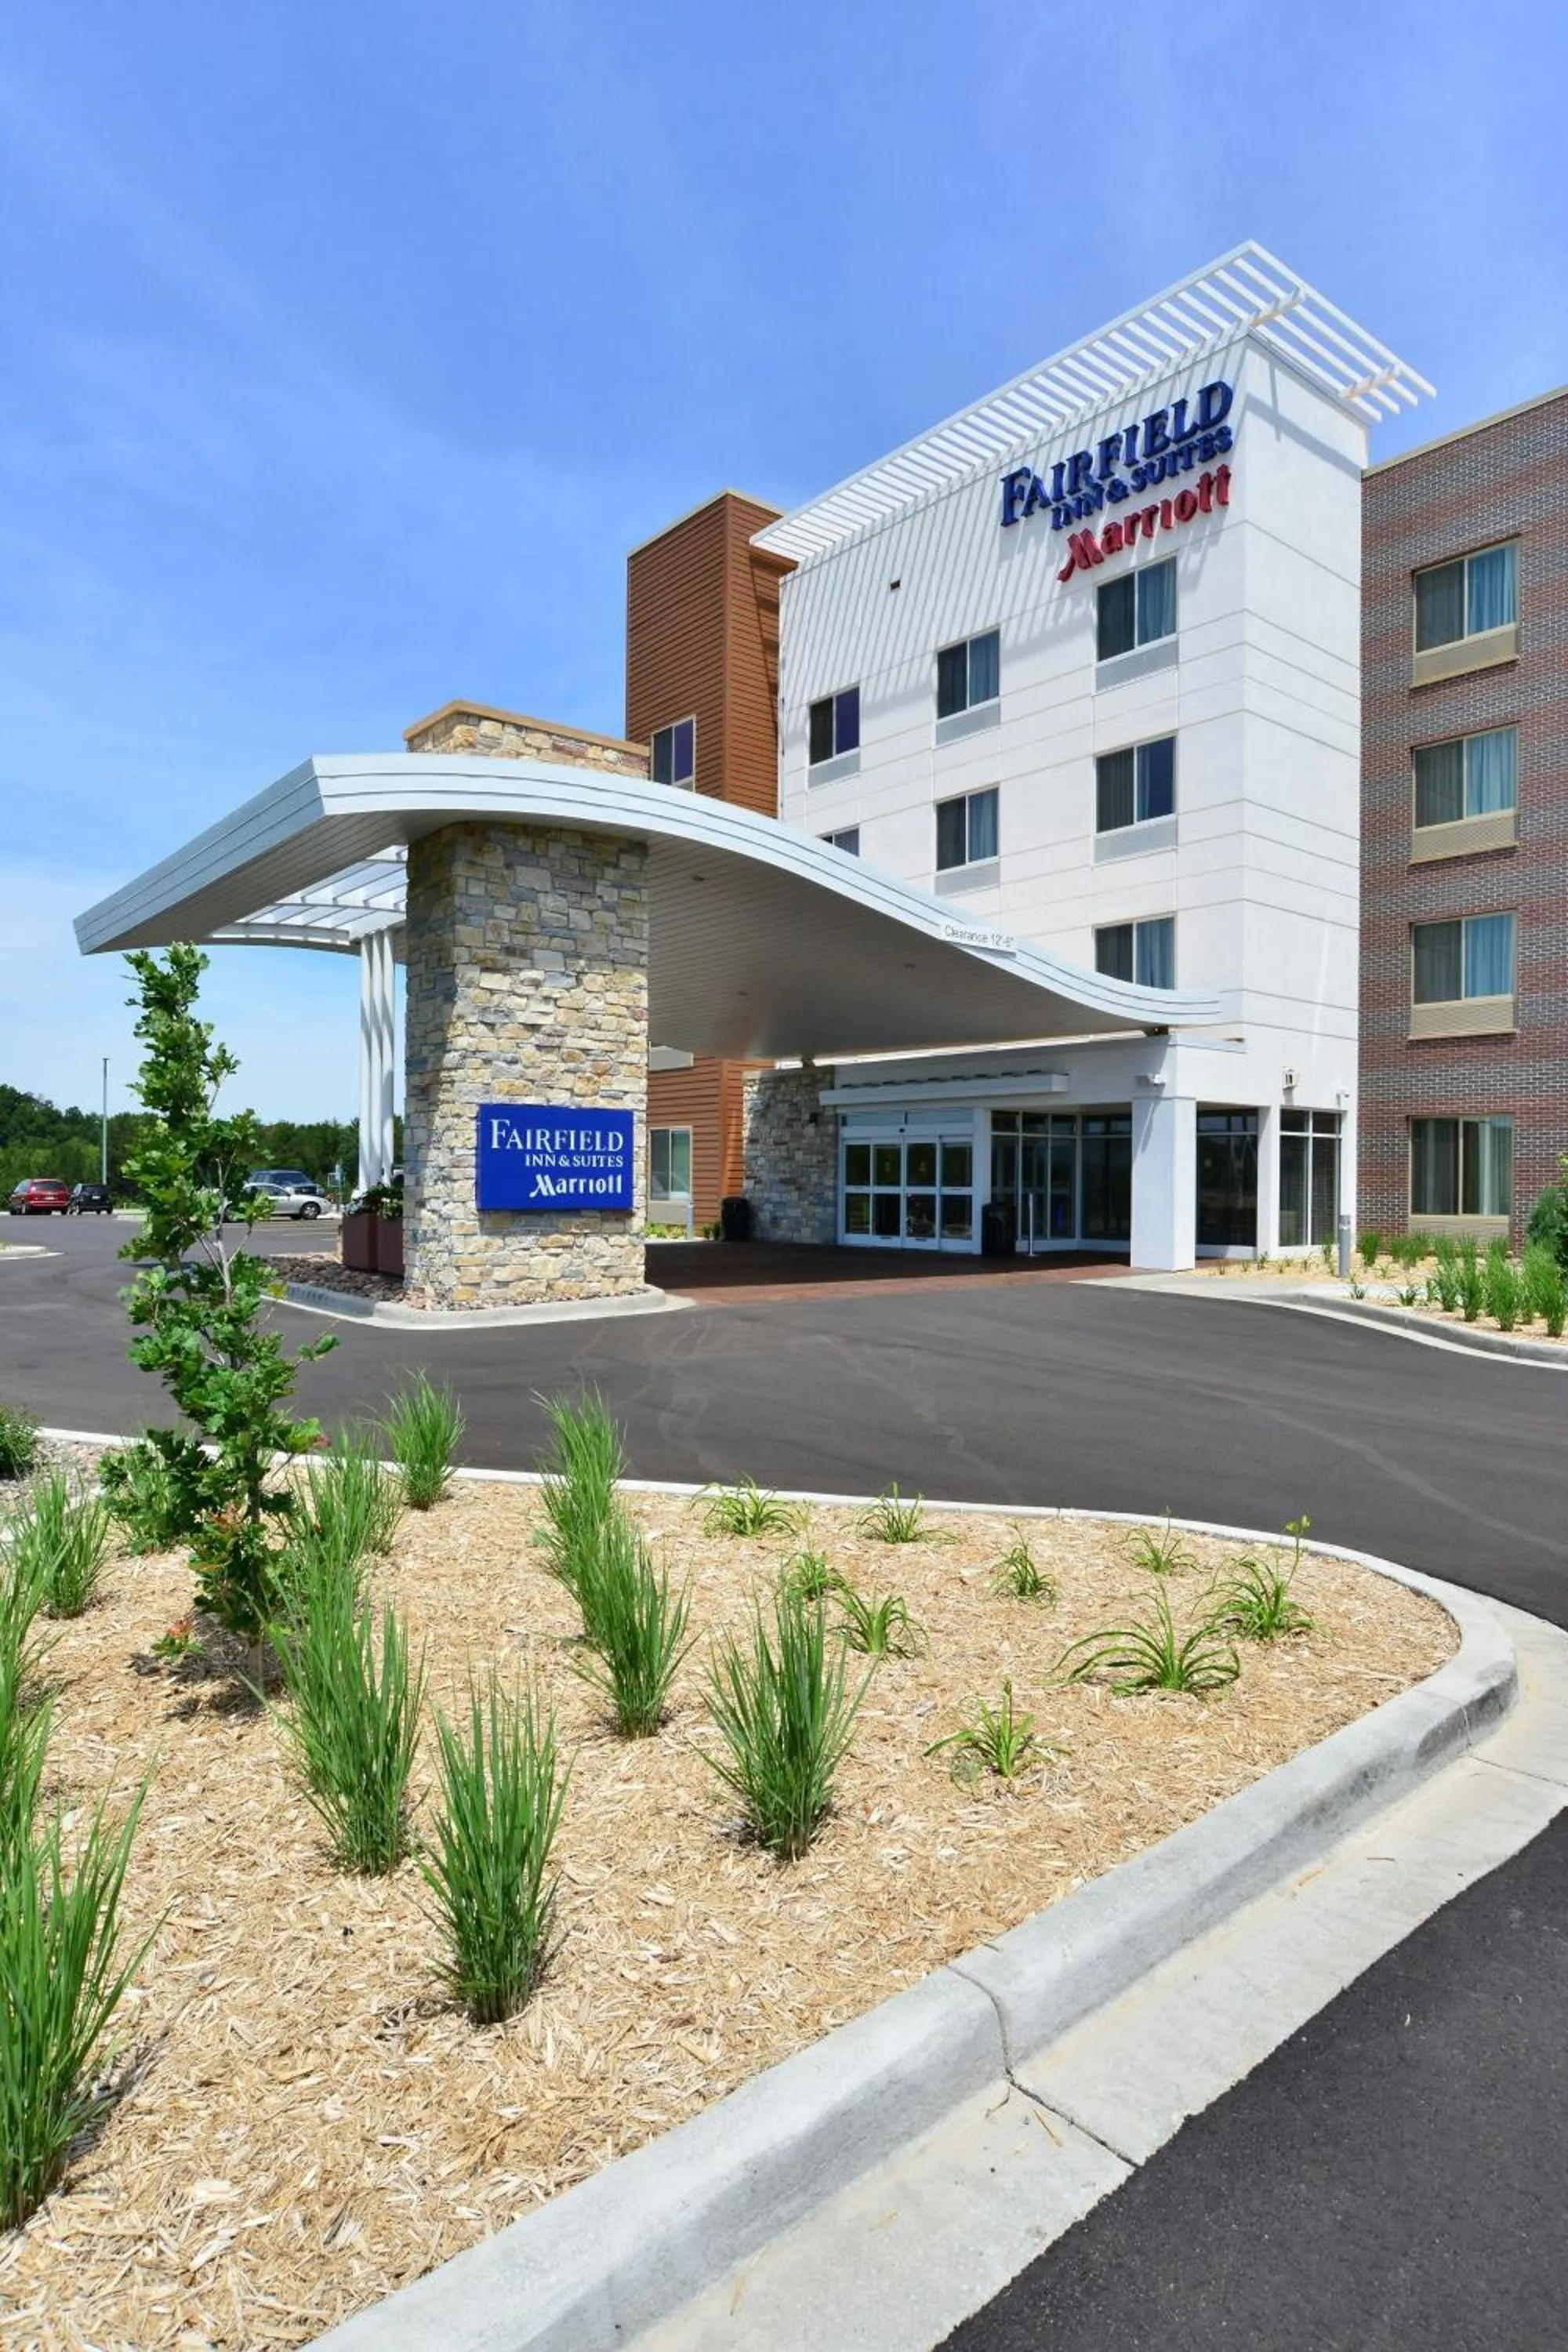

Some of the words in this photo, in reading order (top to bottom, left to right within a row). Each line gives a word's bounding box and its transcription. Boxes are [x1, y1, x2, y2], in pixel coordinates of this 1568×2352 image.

[1001, 380, 1233, 528] FAIRFIELD
[1051, 484, 1105, 531] INN
[1105, 478, 1130, 504] &
[1131, 426, 1233, 492] SUITES
[1057, 464, 1232, 582] Marriott
[945, 925, 988, 943] Clearance
[490, 1119, 624, 1152] FAIRFIELD
[525, 1154, 556, 1167] INN
[558, 1155, 570, 1167] &
[573, 1155, 624, 1168] SUITES
[529, 1174, 622, 1198] Marriott
